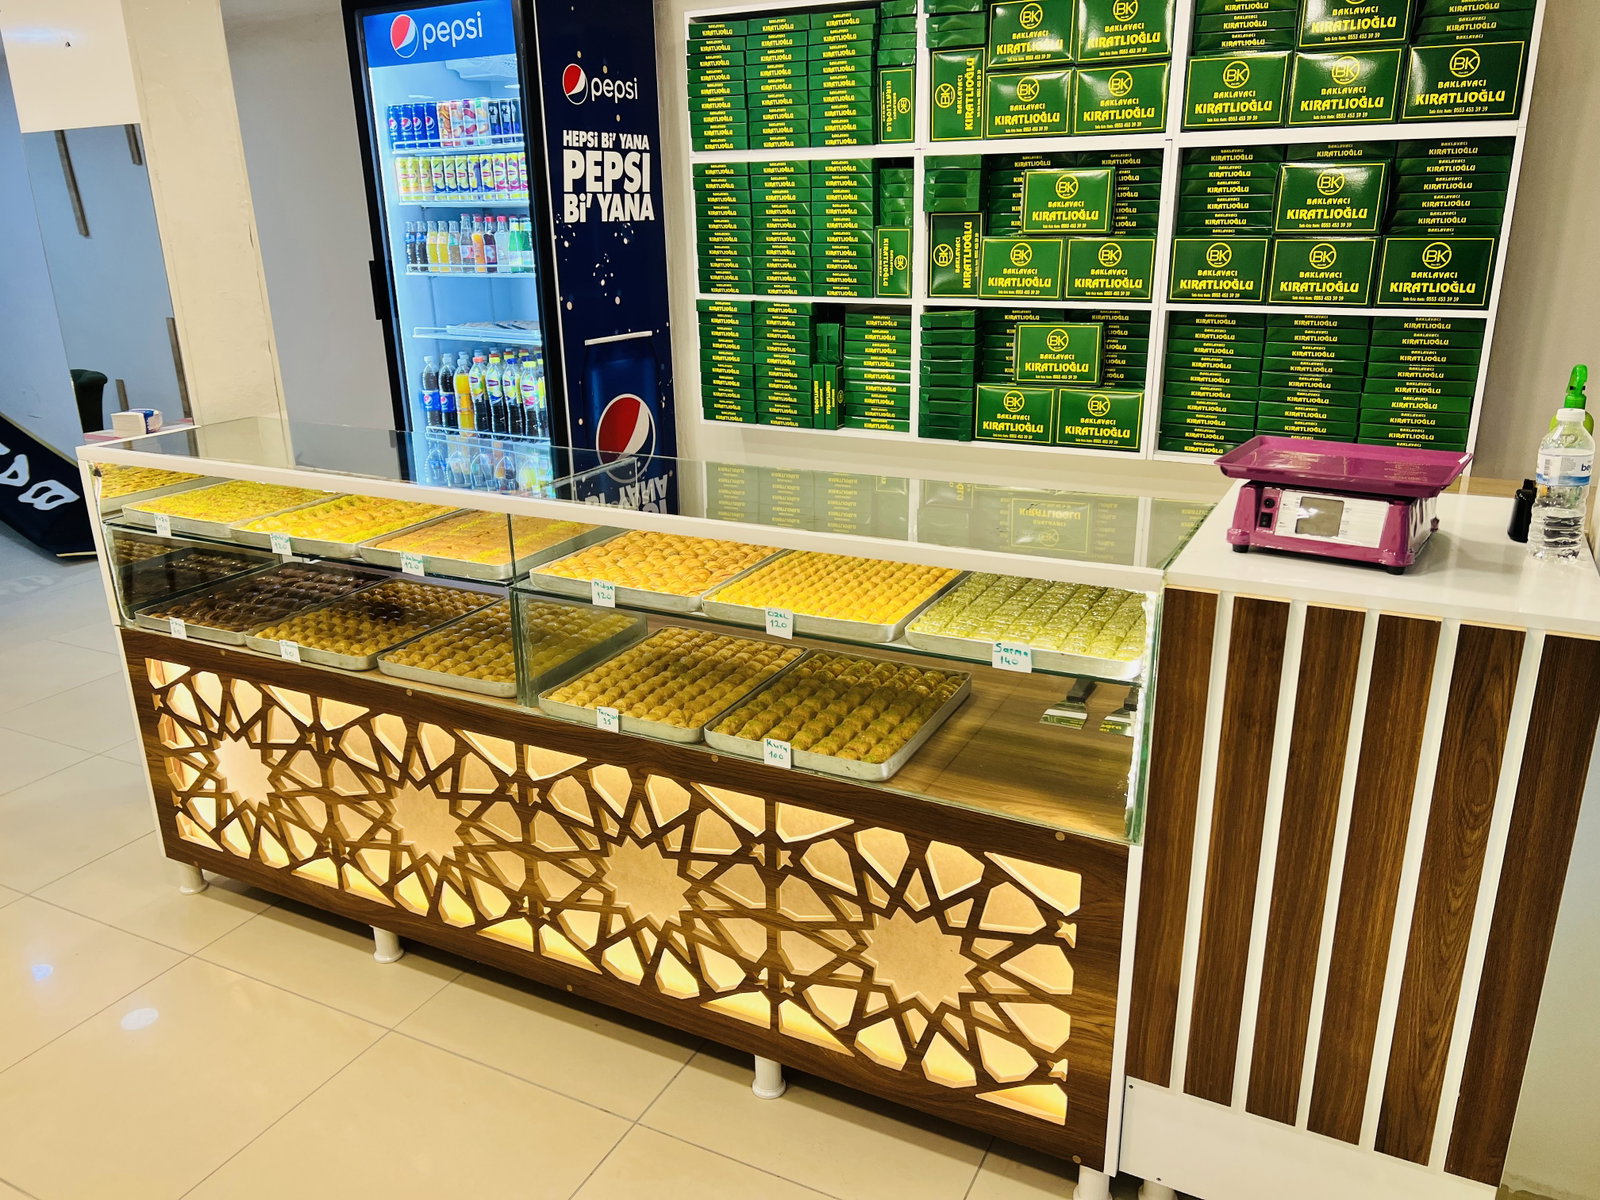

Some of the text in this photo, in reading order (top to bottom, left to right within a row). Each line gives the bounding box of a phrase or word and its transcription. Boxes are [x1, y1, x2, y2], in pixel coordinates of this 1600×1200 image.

[1225, 2, 1268, 11] KIRATLIOĞLU
[1331, 6, 1378, 16] BAKLAVACI
[1449, 3, 1499, 12] KIRATLIOĞLU
[1105, 23, 1144, 33] BAKLAVACI
[1223, 20, 1267, 29] KIRATLIOĞLU
[1311, 15, 1396, 33] KIRATLIOĞLU
[1447, 22, 1496, 31] KIRATLIOĞLU
[422, 11, 482, 51] pepsi
[1012, 30, 1050, 40] BAKLAVACI
[591, 77, 638, 103] pepsi
[1438, 80, 1486, 88] BAKLAVACI
[964, 57, 976, 131] KIRATLIOĞLU
[1213, 90, 1256, 99] BAKLAVACI
[1321, 86, 1366, 95] BAKLAVACI
[1099, 98, 1139, 107] BAKLAVACI
[1415, 89, 1505, 105] KIRATLIOĞLU
[1010, 103, 1045, 111] BAKLAVACI
[1195, 99, 1272, 114] KIRATLIOĞLU
[1301, 96, 1384, 111] KIRATLIOĞLU
[995, 112, 1060, 126] KIRATLIOĞLU
[1084, 106, 1155, 122] KIRATLIOĞLU
[619, 133, 650, 150] YANA
[1317, 149, 1362, 157] KIRATLIOĞLU
[563, 149, 651, 193] PEPSI
[1424, 182, 1472, 190] KIRATLIOĞLU
[597, 193, 655, 222] YANA
[1287, 207, 1368, 220] KIRATLIOĞLU
[1032, 209, 1099, 222] KIRATLIOĞLU
[962, 221, 973, 289] KIRATLIOĞLU
[988, 274, 1051, 288] KIRATLIOĞLU
[1075, 277, 1142, 290] KIRATLIOĞLU
[1180, 278, 1253, 290] KIRATLIOĞLU
[1280, 281, 1359, 292] KIRATLIOĞLU
[1390, 281, 1476, 293] KIRATLIOĞLU
[1025, 362, 1089, 373] KIRATLIOĞLU
[983, 421, 1043, 434] KIRATLIOĞLU
[1065, 425, 1130, 438] KIRATLIOĞLU
[597, 591, 611, 600] 120
[770, 619, 787, 628] 120
[1000, 655, 1018, 665] 140
[769, 751, 783, 760] 100
